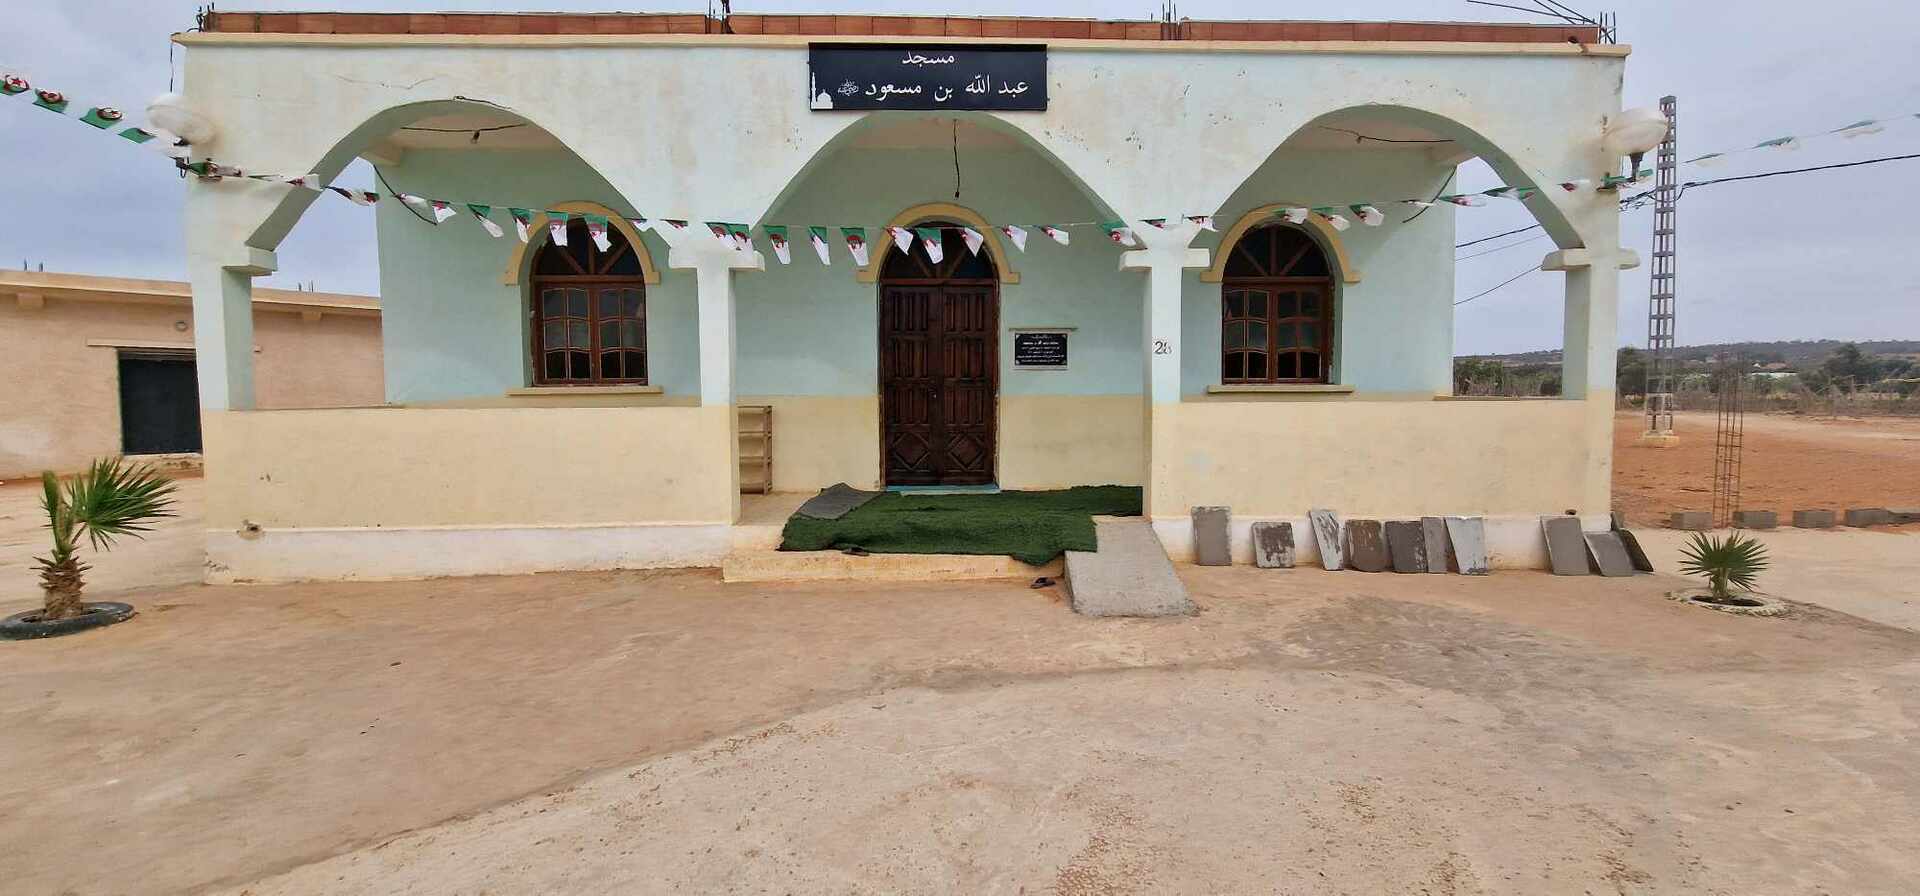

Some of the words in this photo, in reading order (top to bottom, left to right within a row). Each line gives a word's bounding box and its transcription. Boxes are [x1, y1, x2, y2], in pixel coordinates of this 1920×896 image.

[901, 51, 956, 67] مسجد
[865, 83, 923, 101] مسعود
[934, 85, 954, 102] بن
[998, 79, 1030, 98] عبد
